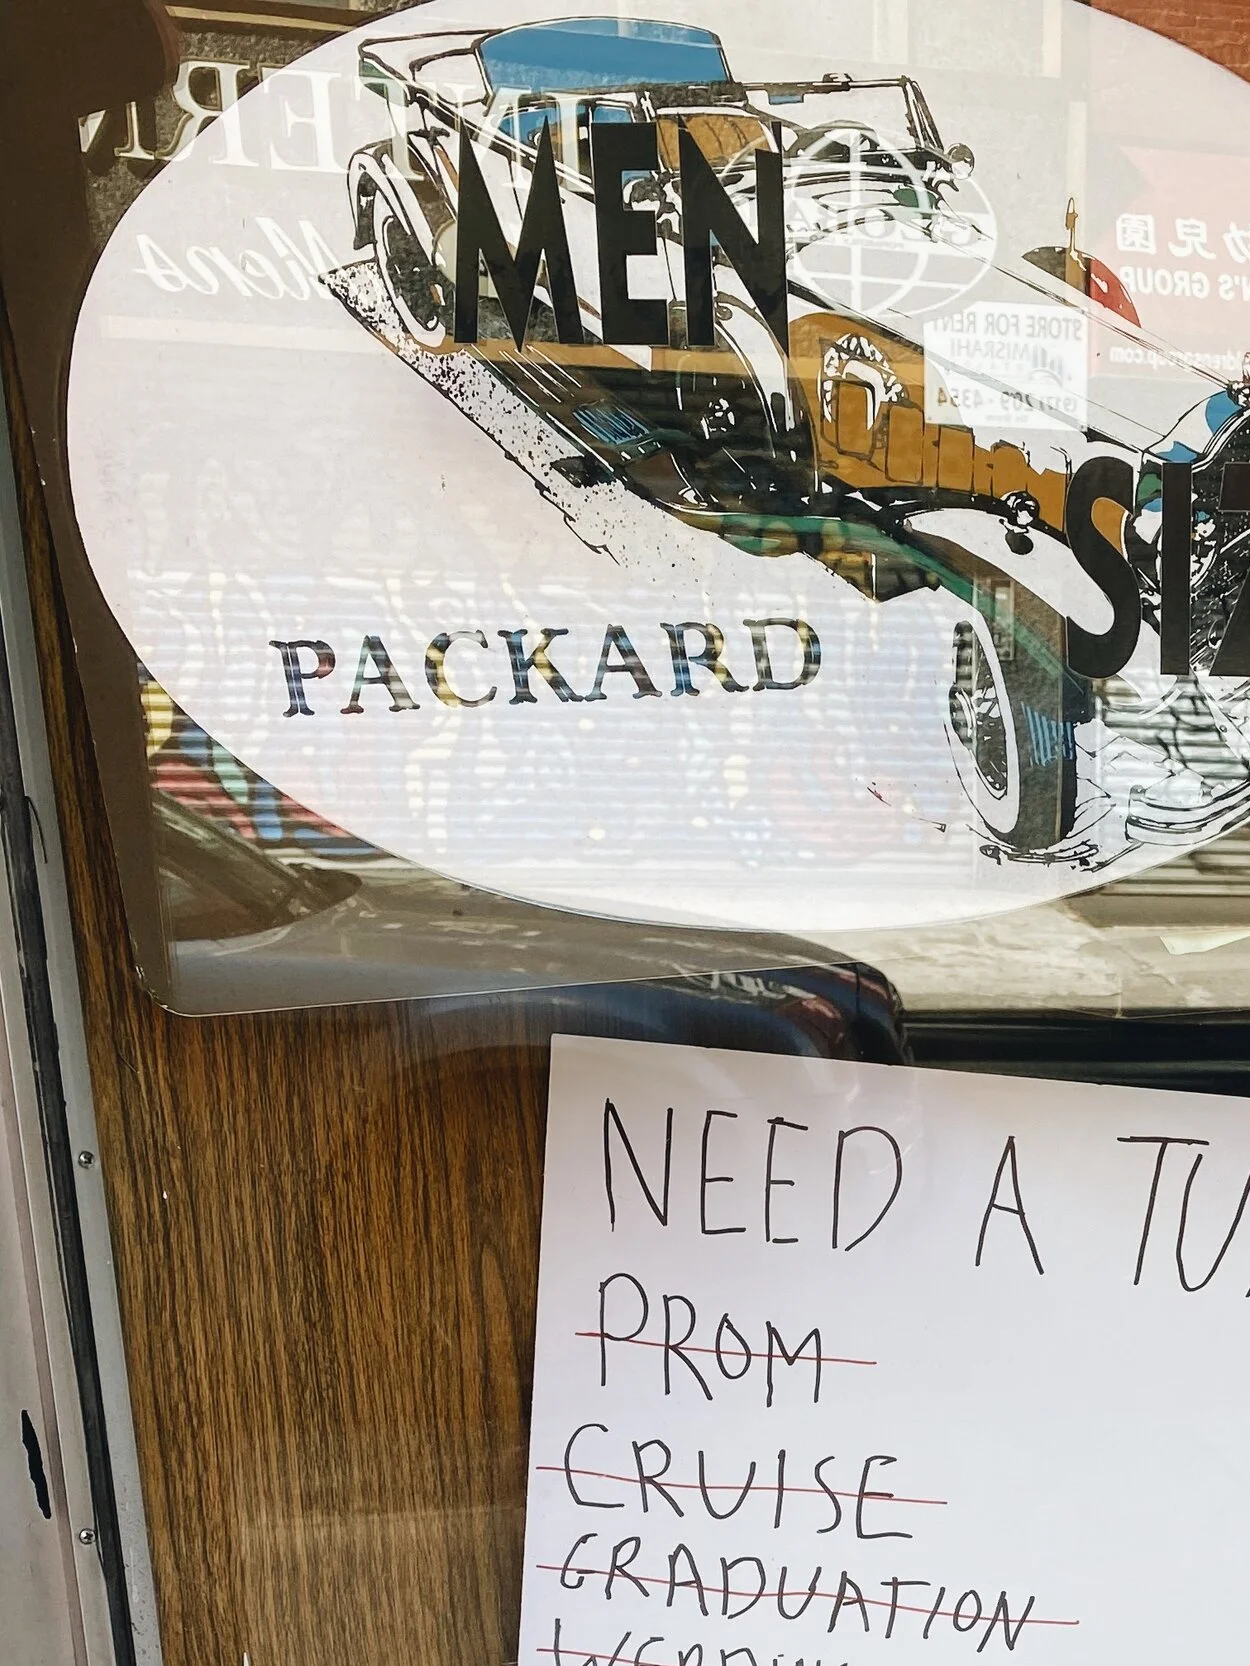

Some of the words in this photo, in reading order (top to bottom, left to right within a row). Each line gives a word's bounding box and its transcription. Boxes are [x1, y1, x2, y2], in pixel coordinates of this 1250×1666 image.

[453, 115, 790, 352] MEN
[269, 617, 821, 717] PACKARD
[603, 1098, 902, 1252] NEED
[976, 1136, 1044, 1275] A
[598, 1273, 822, 1407] PROM
[564, 1423, 912, 1538] CRUISE
[560, 1532, 1034, 1653] GRADUATION
